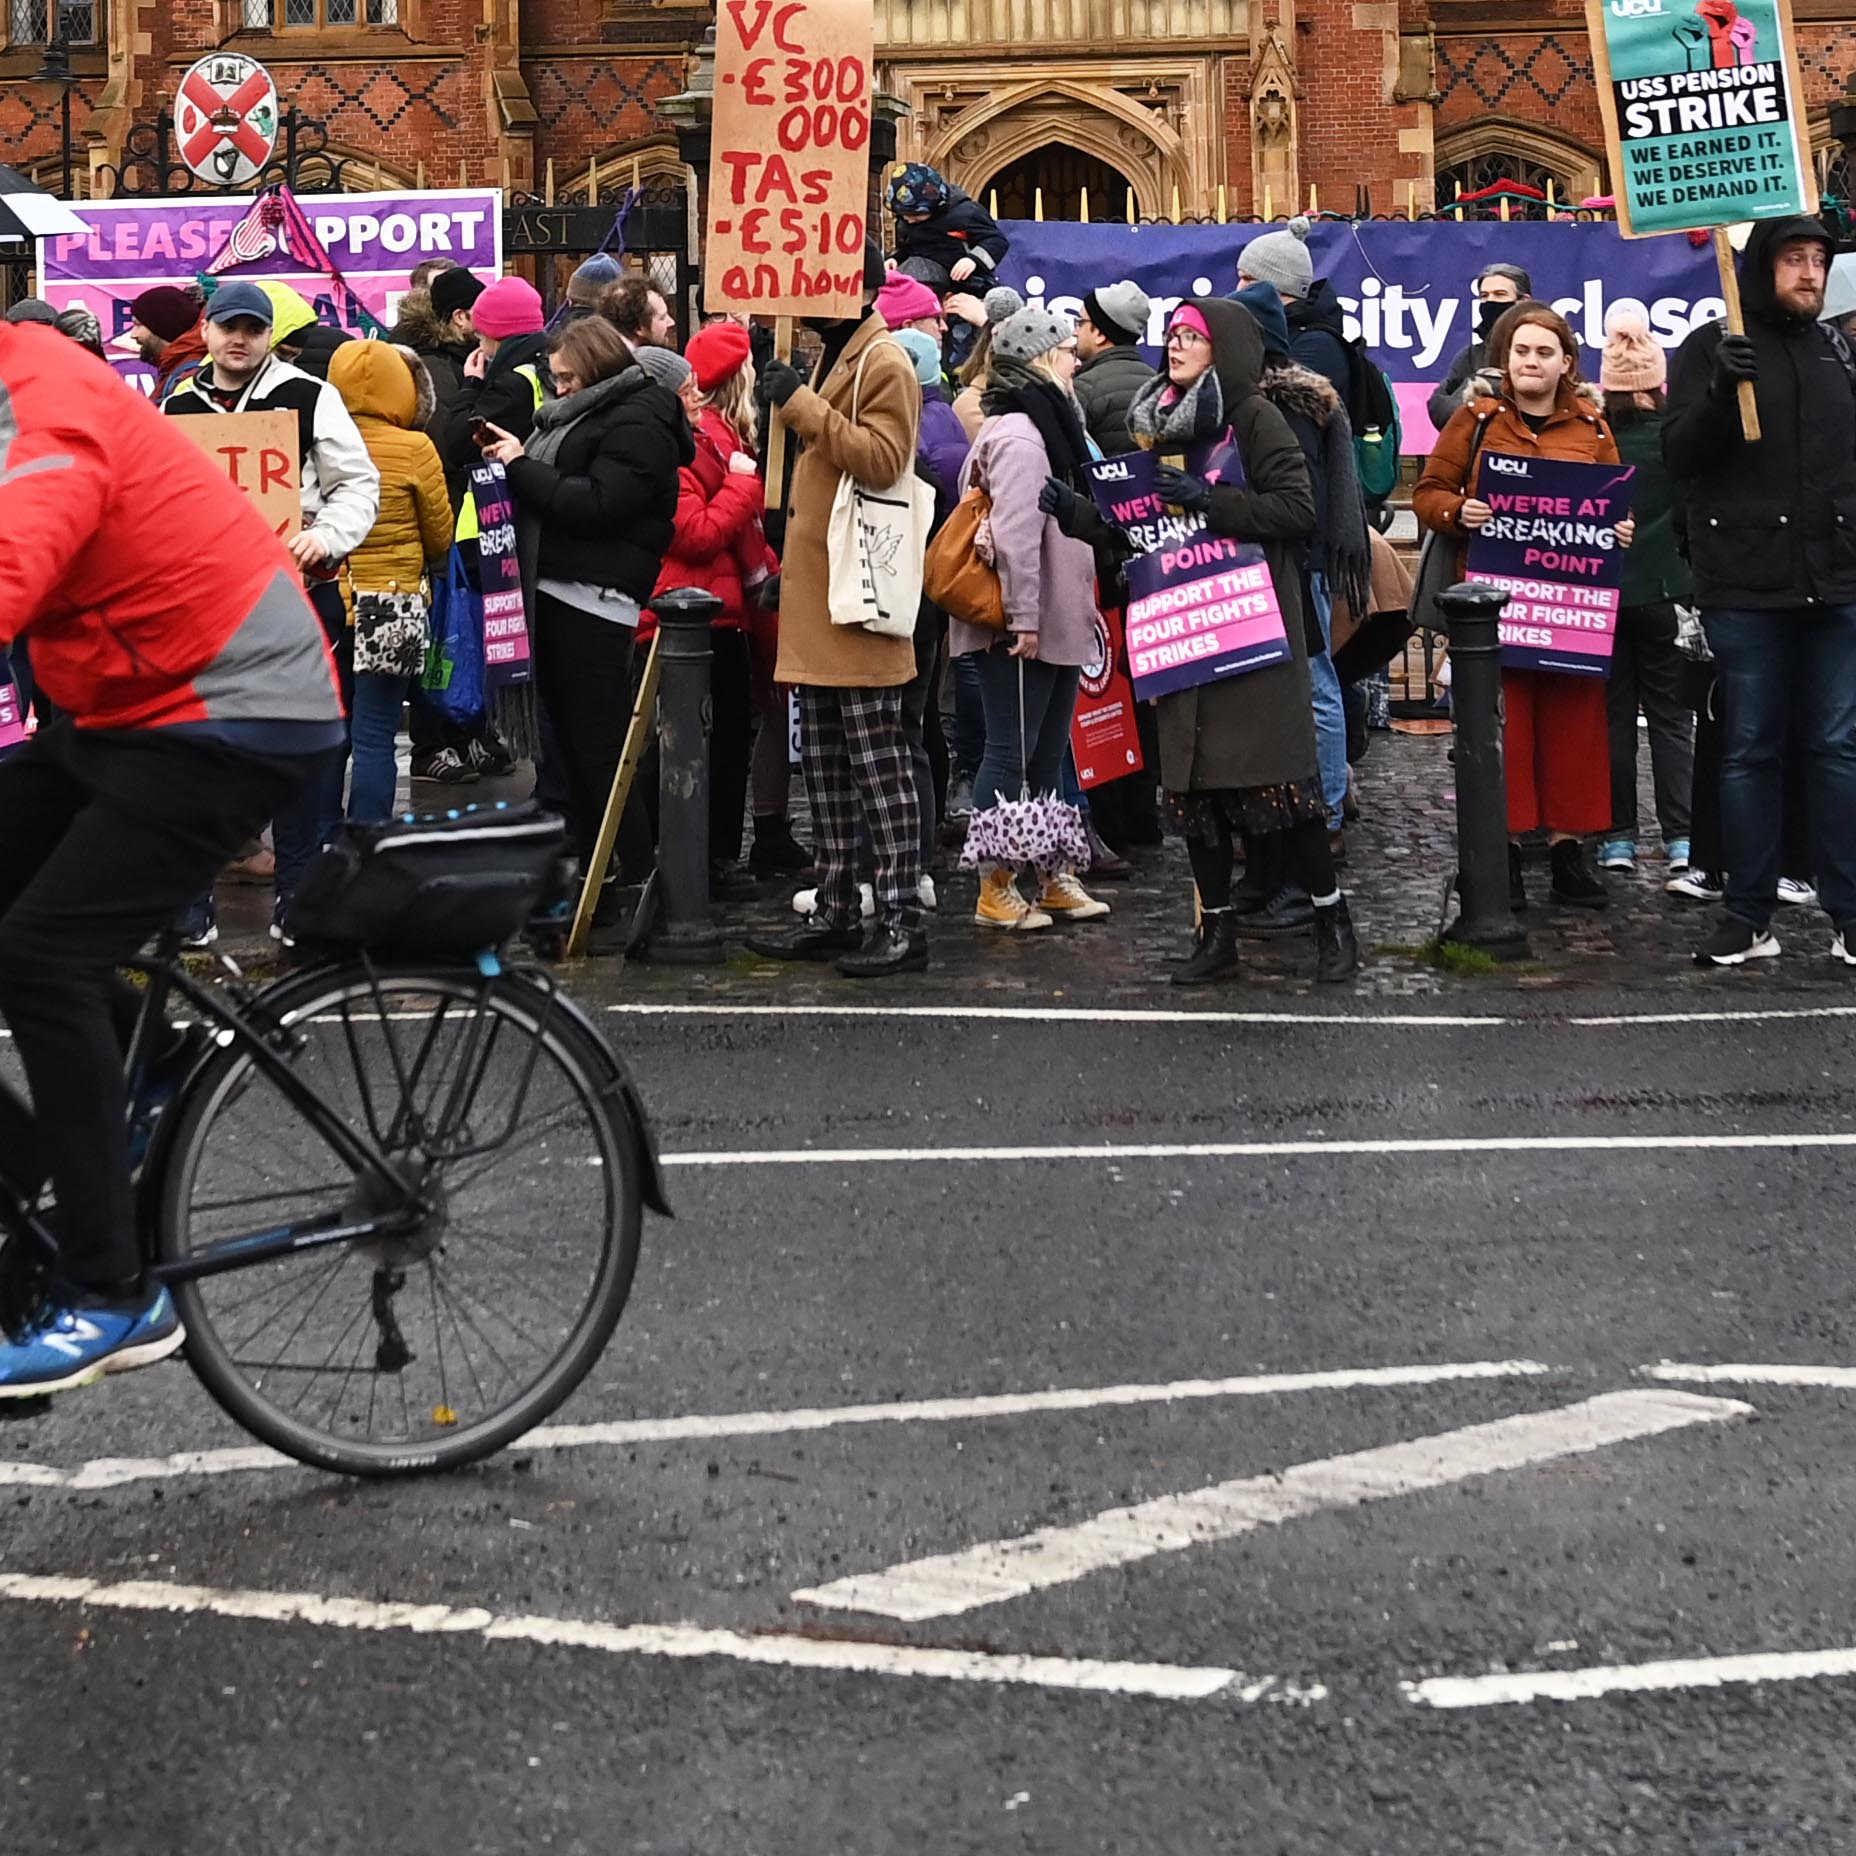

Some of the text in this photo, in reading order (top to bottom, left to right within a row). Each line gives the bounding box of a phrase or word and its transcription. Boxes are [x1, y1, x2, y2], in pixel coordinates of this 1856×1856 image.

[726, 0, 807, 54] VC
[1621, 63, 1776, 100] USS PENSION
[1625, 86, 1780, 138] STRIKE
[1631, 131, 1781, 164] WE EARNED IT.
[1634, 153, 1785, 186] WE DESERVE IT.
[1636, 175, 1788, 208] WE DEMAND IT.
[721, 257, 862, 299] an hour
[1487, 493, 1611, 517] WE'RE AT
[1161, 539, 1239, 575] POINT
[1524, 548, 1605, 576] POINT
[1130, 568, 1265, 623] SUPPORT THE
[1572, 587, 1613, 608] THE
[1131, 594, 1268, 648] FOUR FIGHTS
[1532, 606, 1608, 630] FIGHTS
[1135, 634, 1220, 673] STRIKES
